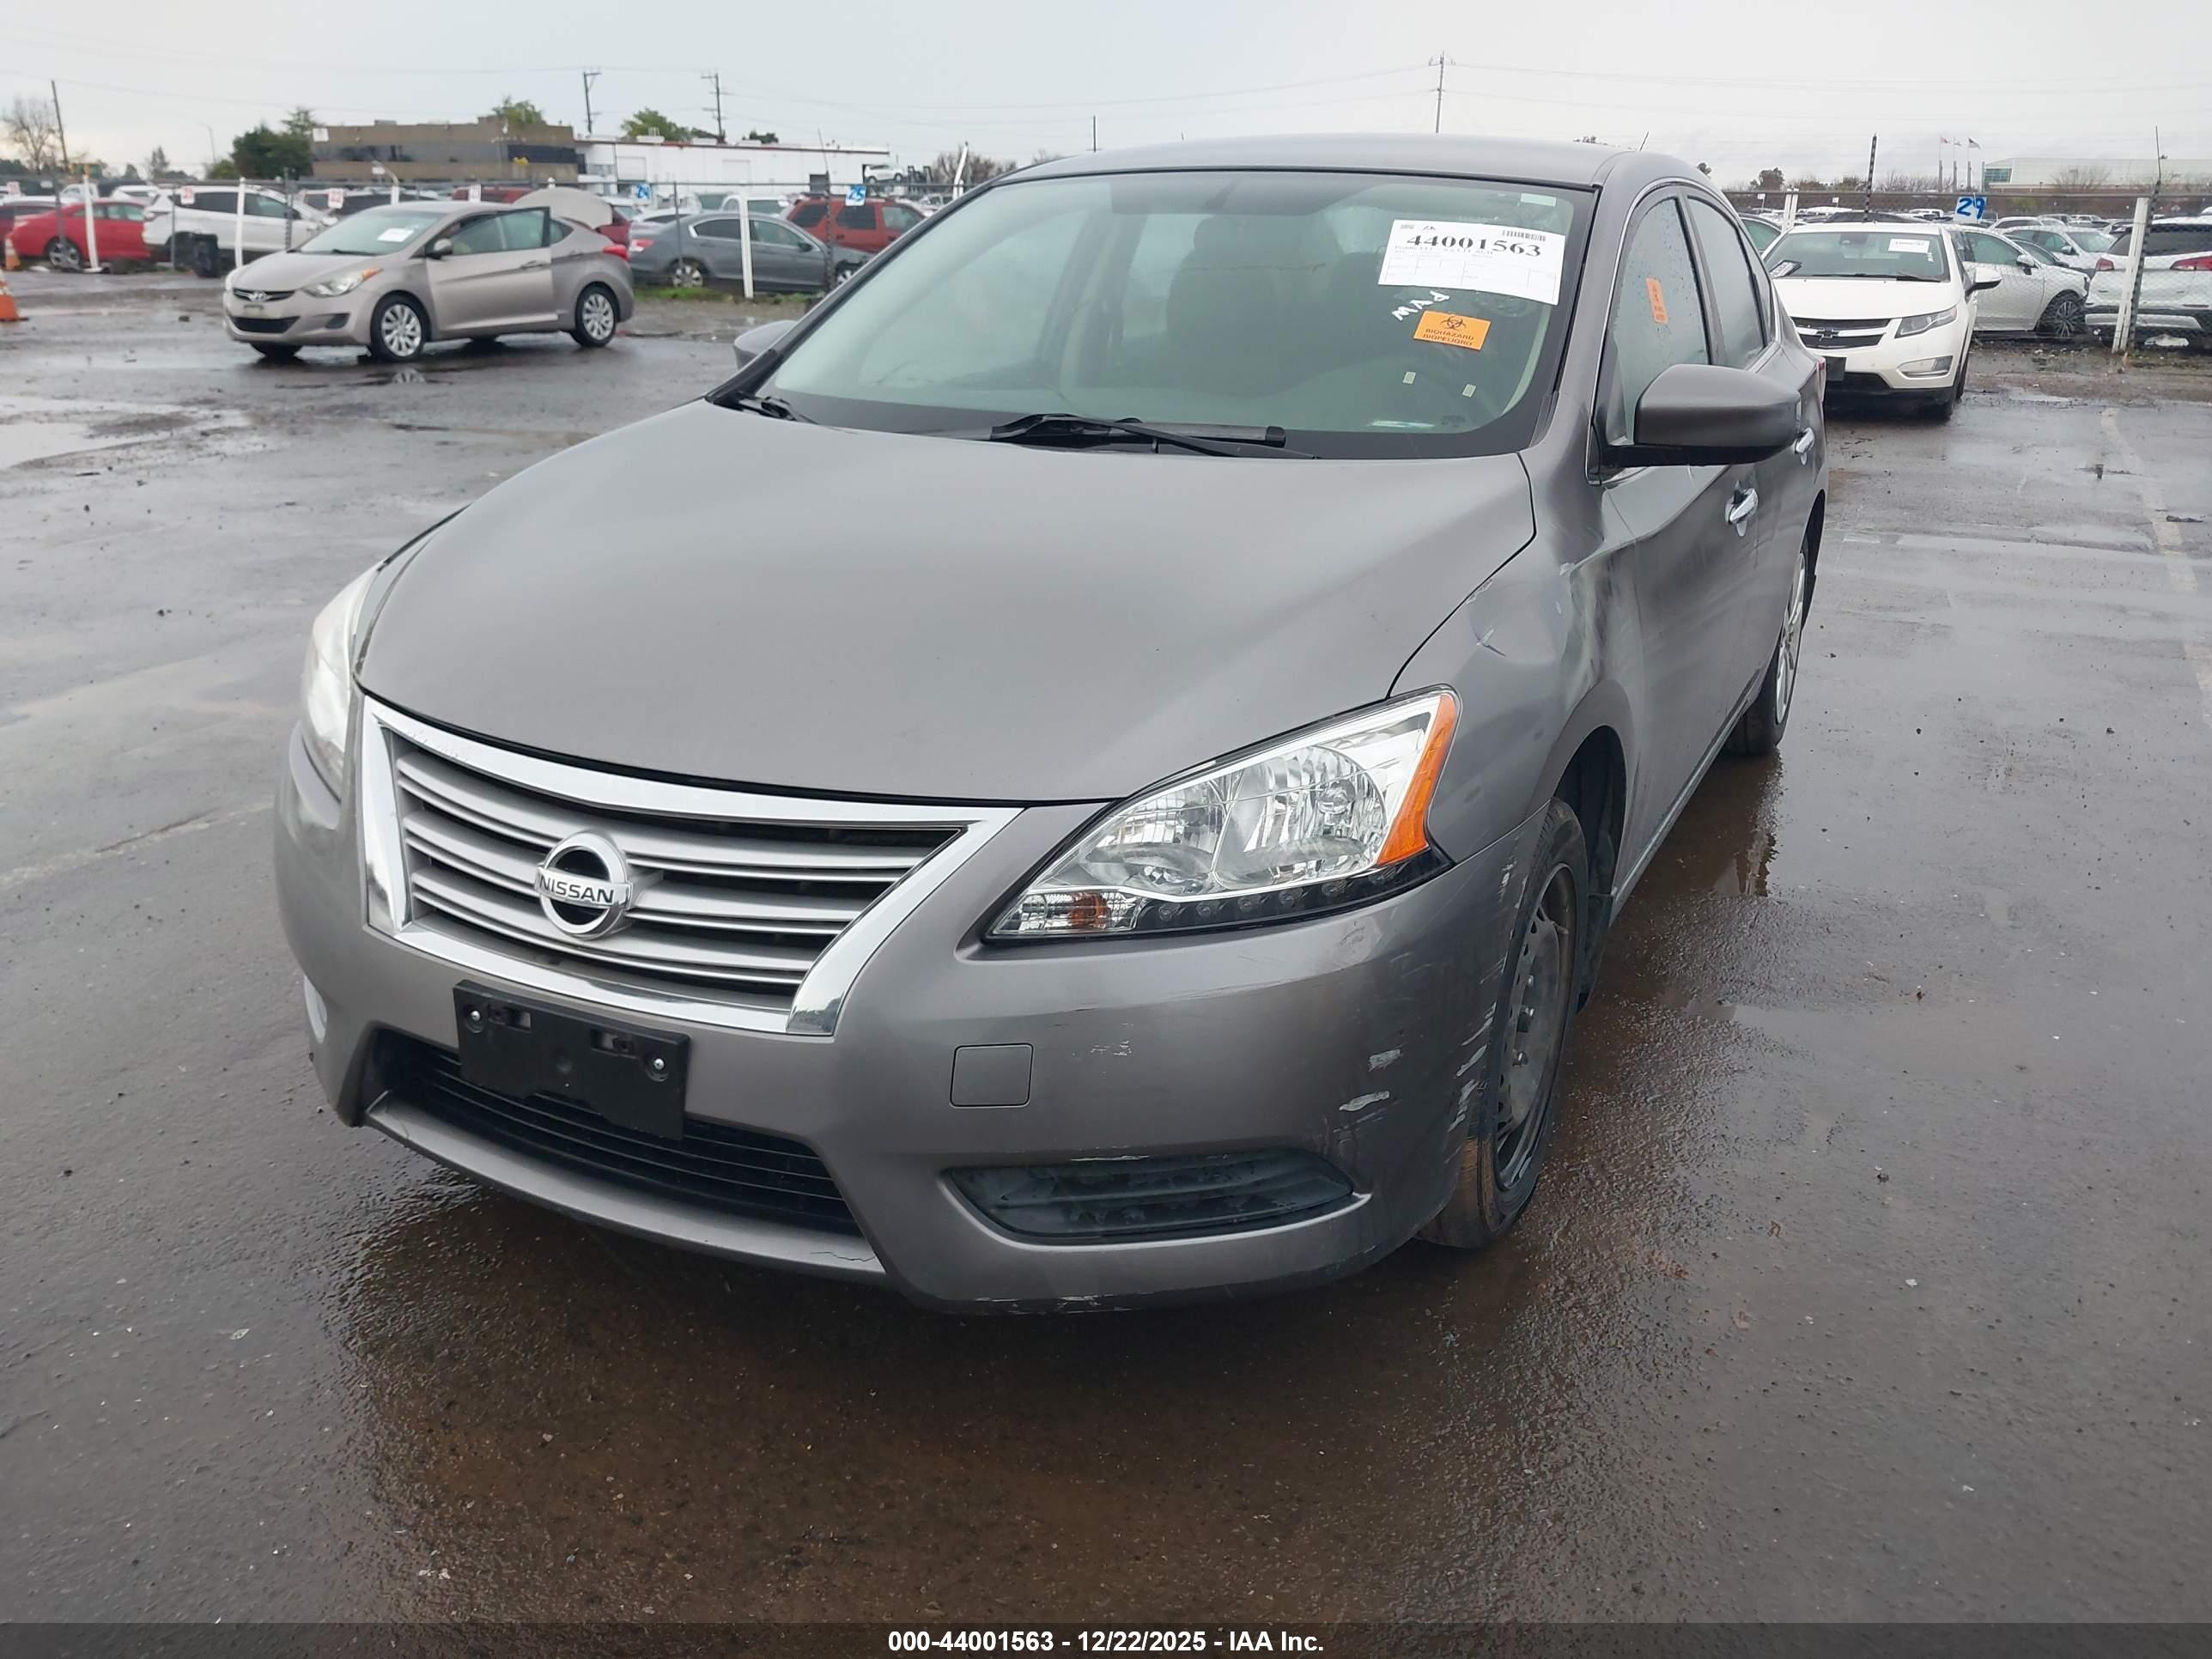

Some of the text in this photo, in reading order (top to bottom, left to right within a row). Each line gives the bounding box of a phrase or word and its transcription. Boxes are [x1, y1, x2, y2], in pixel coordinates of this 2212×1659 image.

[1957, 197, 1985, 220] 29
[1407, 234, 1540, 257] 44001563
[1425, 328, 1474, 341] BIOHAZARD
[539, 874, 614, 903] NISSAN
